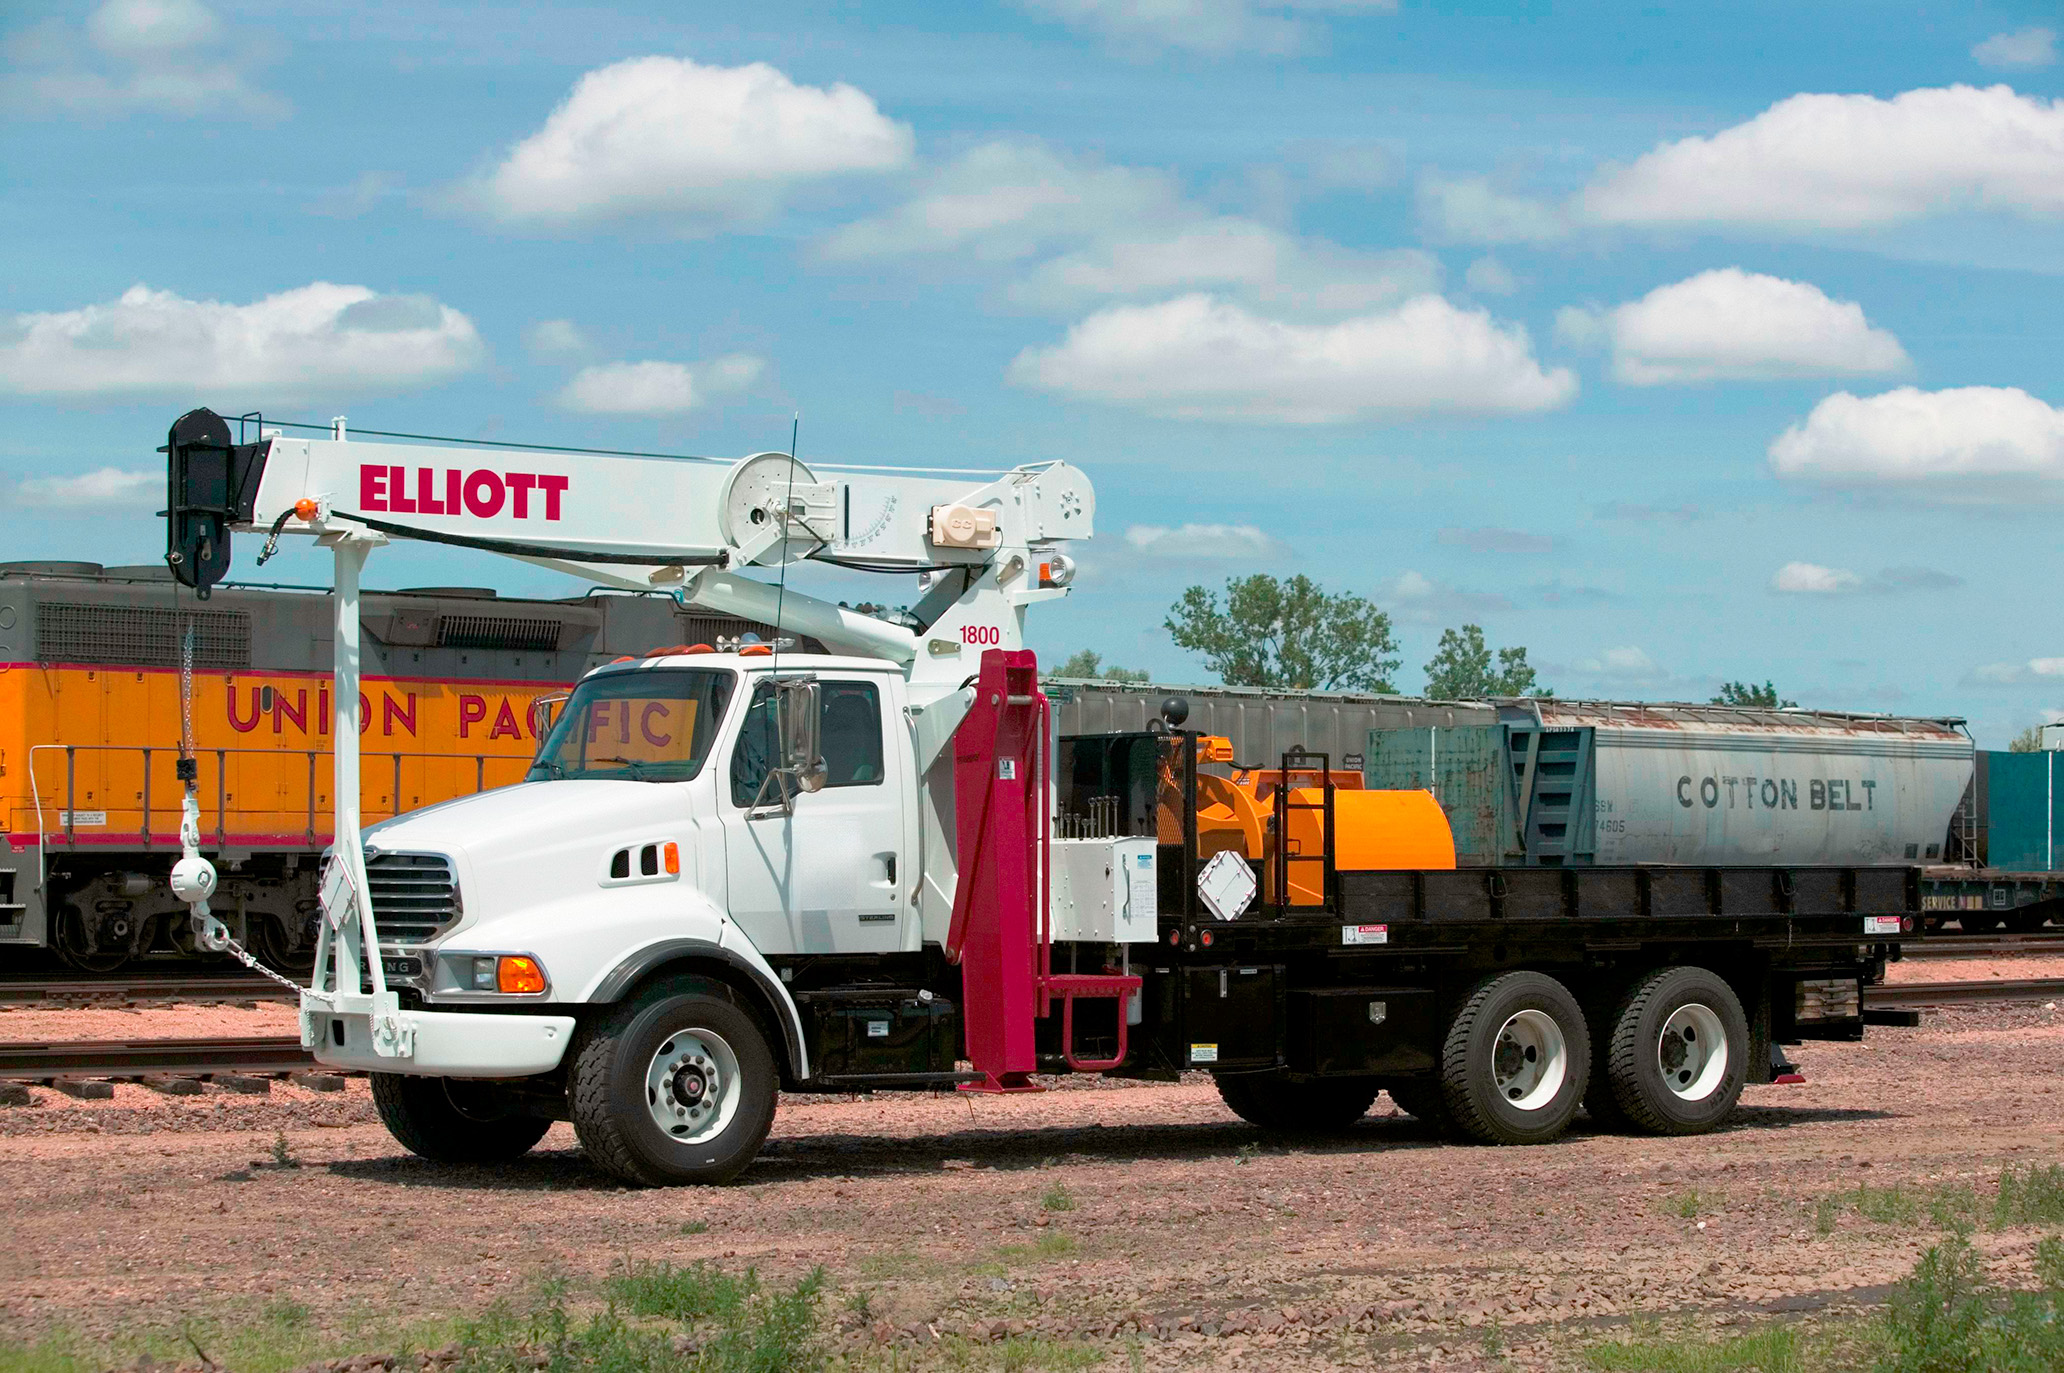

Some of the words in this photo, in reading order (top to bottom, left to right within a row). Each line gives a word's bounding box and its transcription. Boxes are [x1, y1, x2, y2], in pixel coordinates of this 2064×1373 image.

[360, 464, 569, 521] ELLIOTT
[960, 625, 999, 645] 1800
[1677, 775, 1798, 811] COTTON
[1810, 779, 1877, 811] BELT
[1921, 895, 1956, 911] SERVICE
